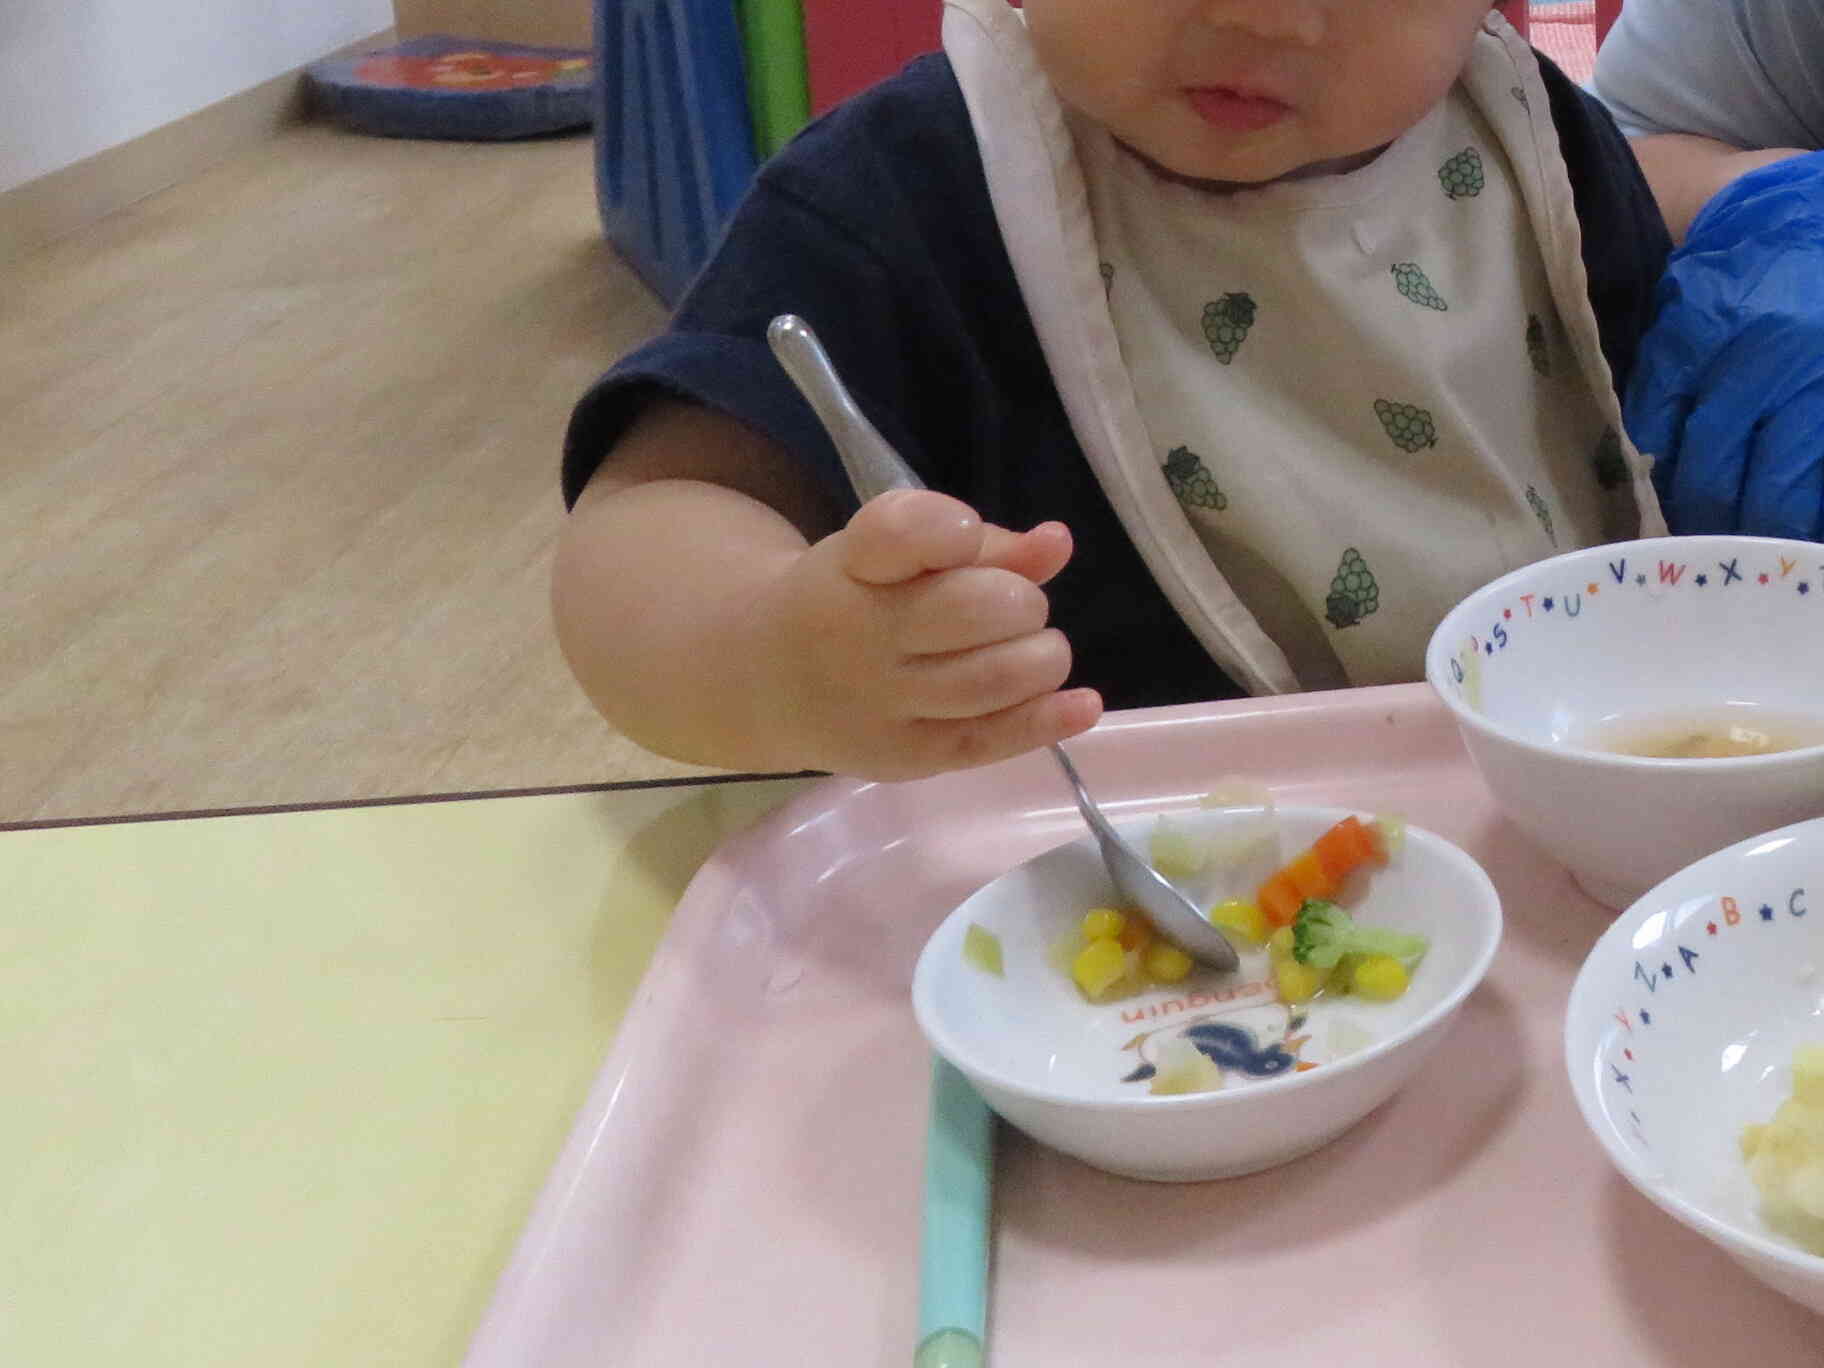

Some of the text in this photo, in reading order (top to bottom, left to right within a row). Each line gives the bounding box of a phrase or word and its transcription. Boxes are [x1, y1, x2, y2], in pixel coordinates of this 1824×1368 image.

[1492, 622, 1508, 649] S
[1519, 593, 1536, 617] T
[1563, 593, 1581, 617] U
[1609, 558, 1627, 584] V
[1657, 560, 1686, 584] W
[1719, 558, 1743, 586] X
[1777, 555, 1798, 577] Y
[1678, 944, 1700, 974] A
[1719, 895, 1741, 927] B
[1788, 888, 1807, 918] C
